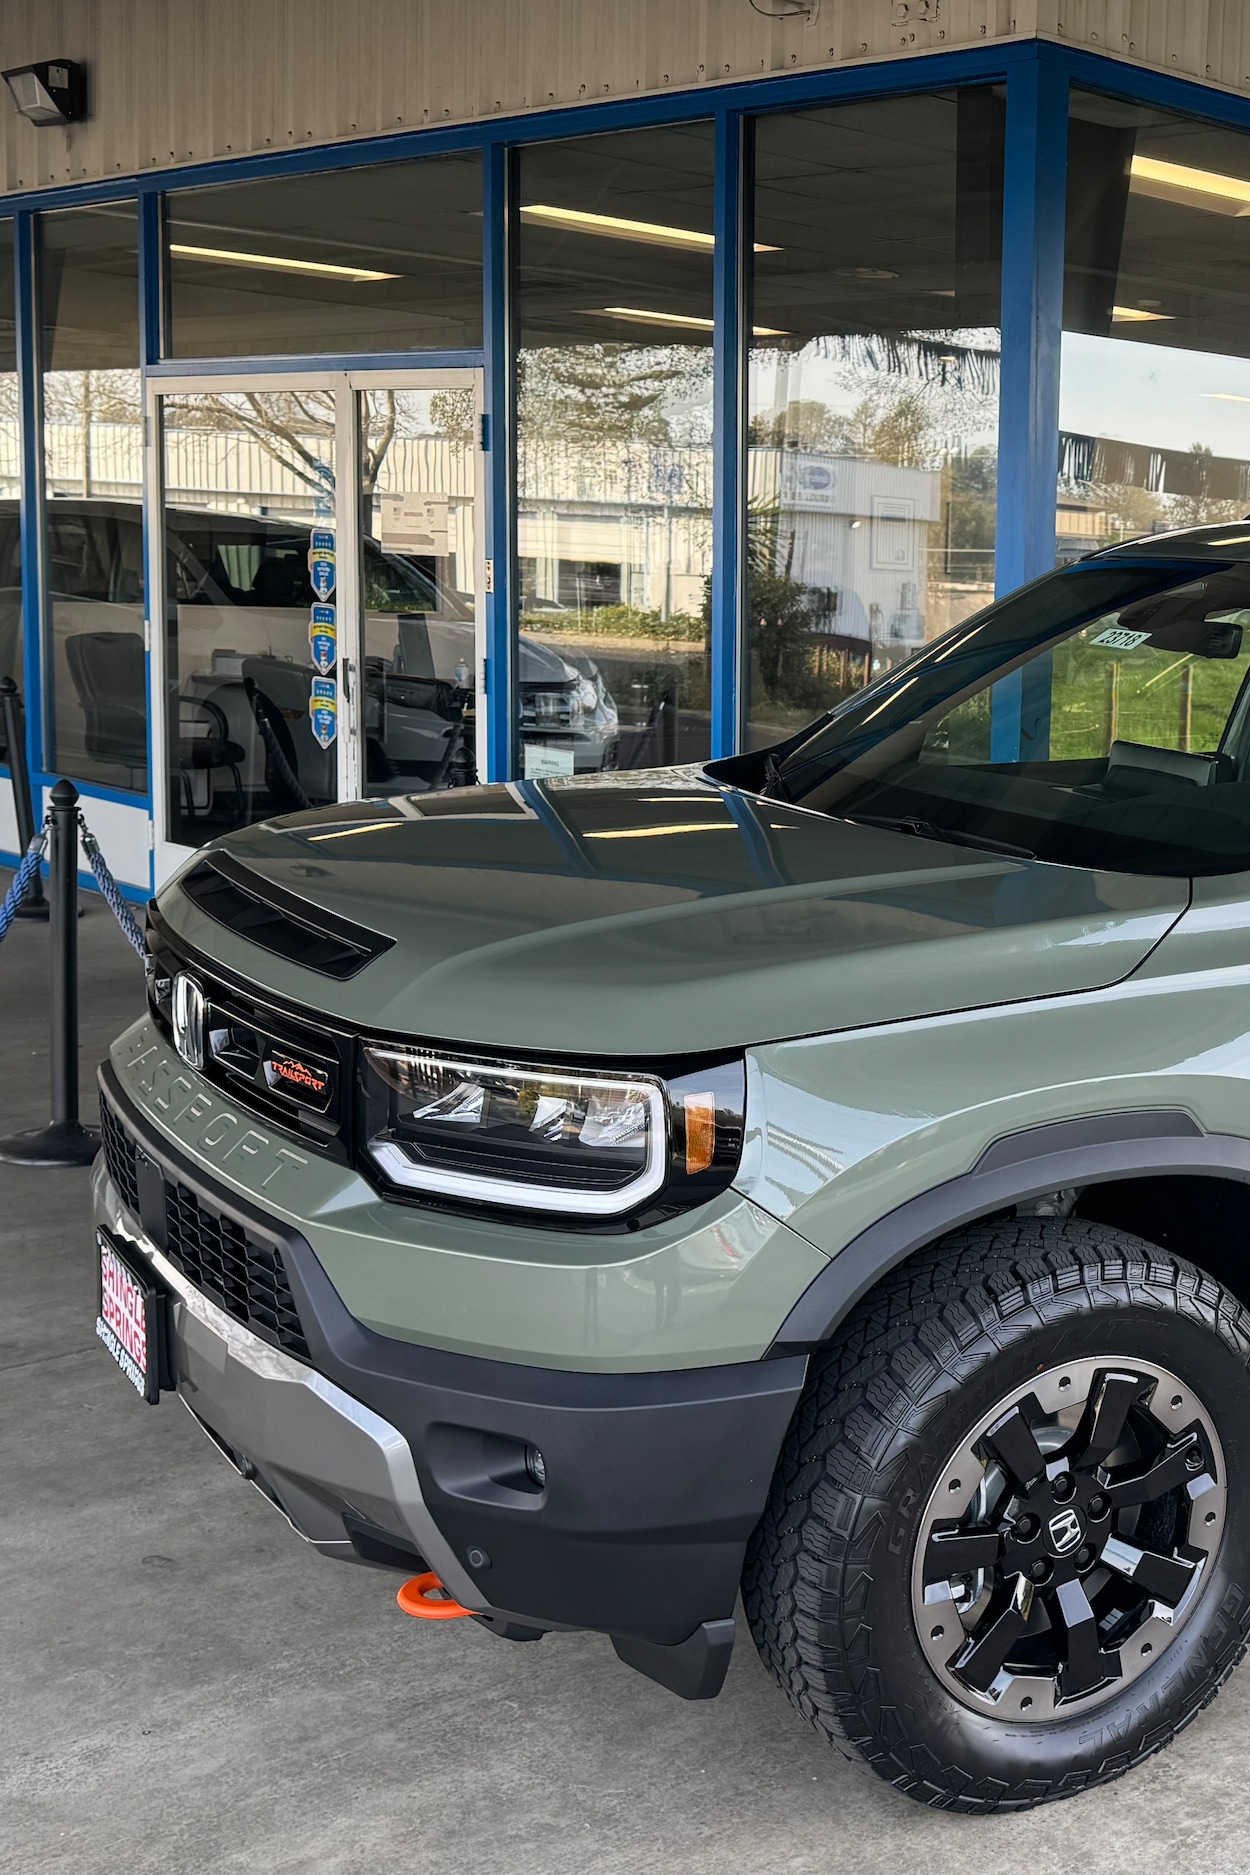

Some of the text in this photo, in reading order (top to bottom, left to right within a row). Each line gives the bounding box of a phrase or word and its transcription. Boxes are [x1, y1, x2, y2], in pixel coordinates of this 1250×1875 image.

[1098, 630, 1143, 647] 23718
[117, 1026, 309, 1191] PASSPORT
[271, 1061, 326, 1091] TRAILSPORT
[101, 1254, 146, 1333] SHINGLE
[1077, 1581, 1247, 1757] GENERAL
